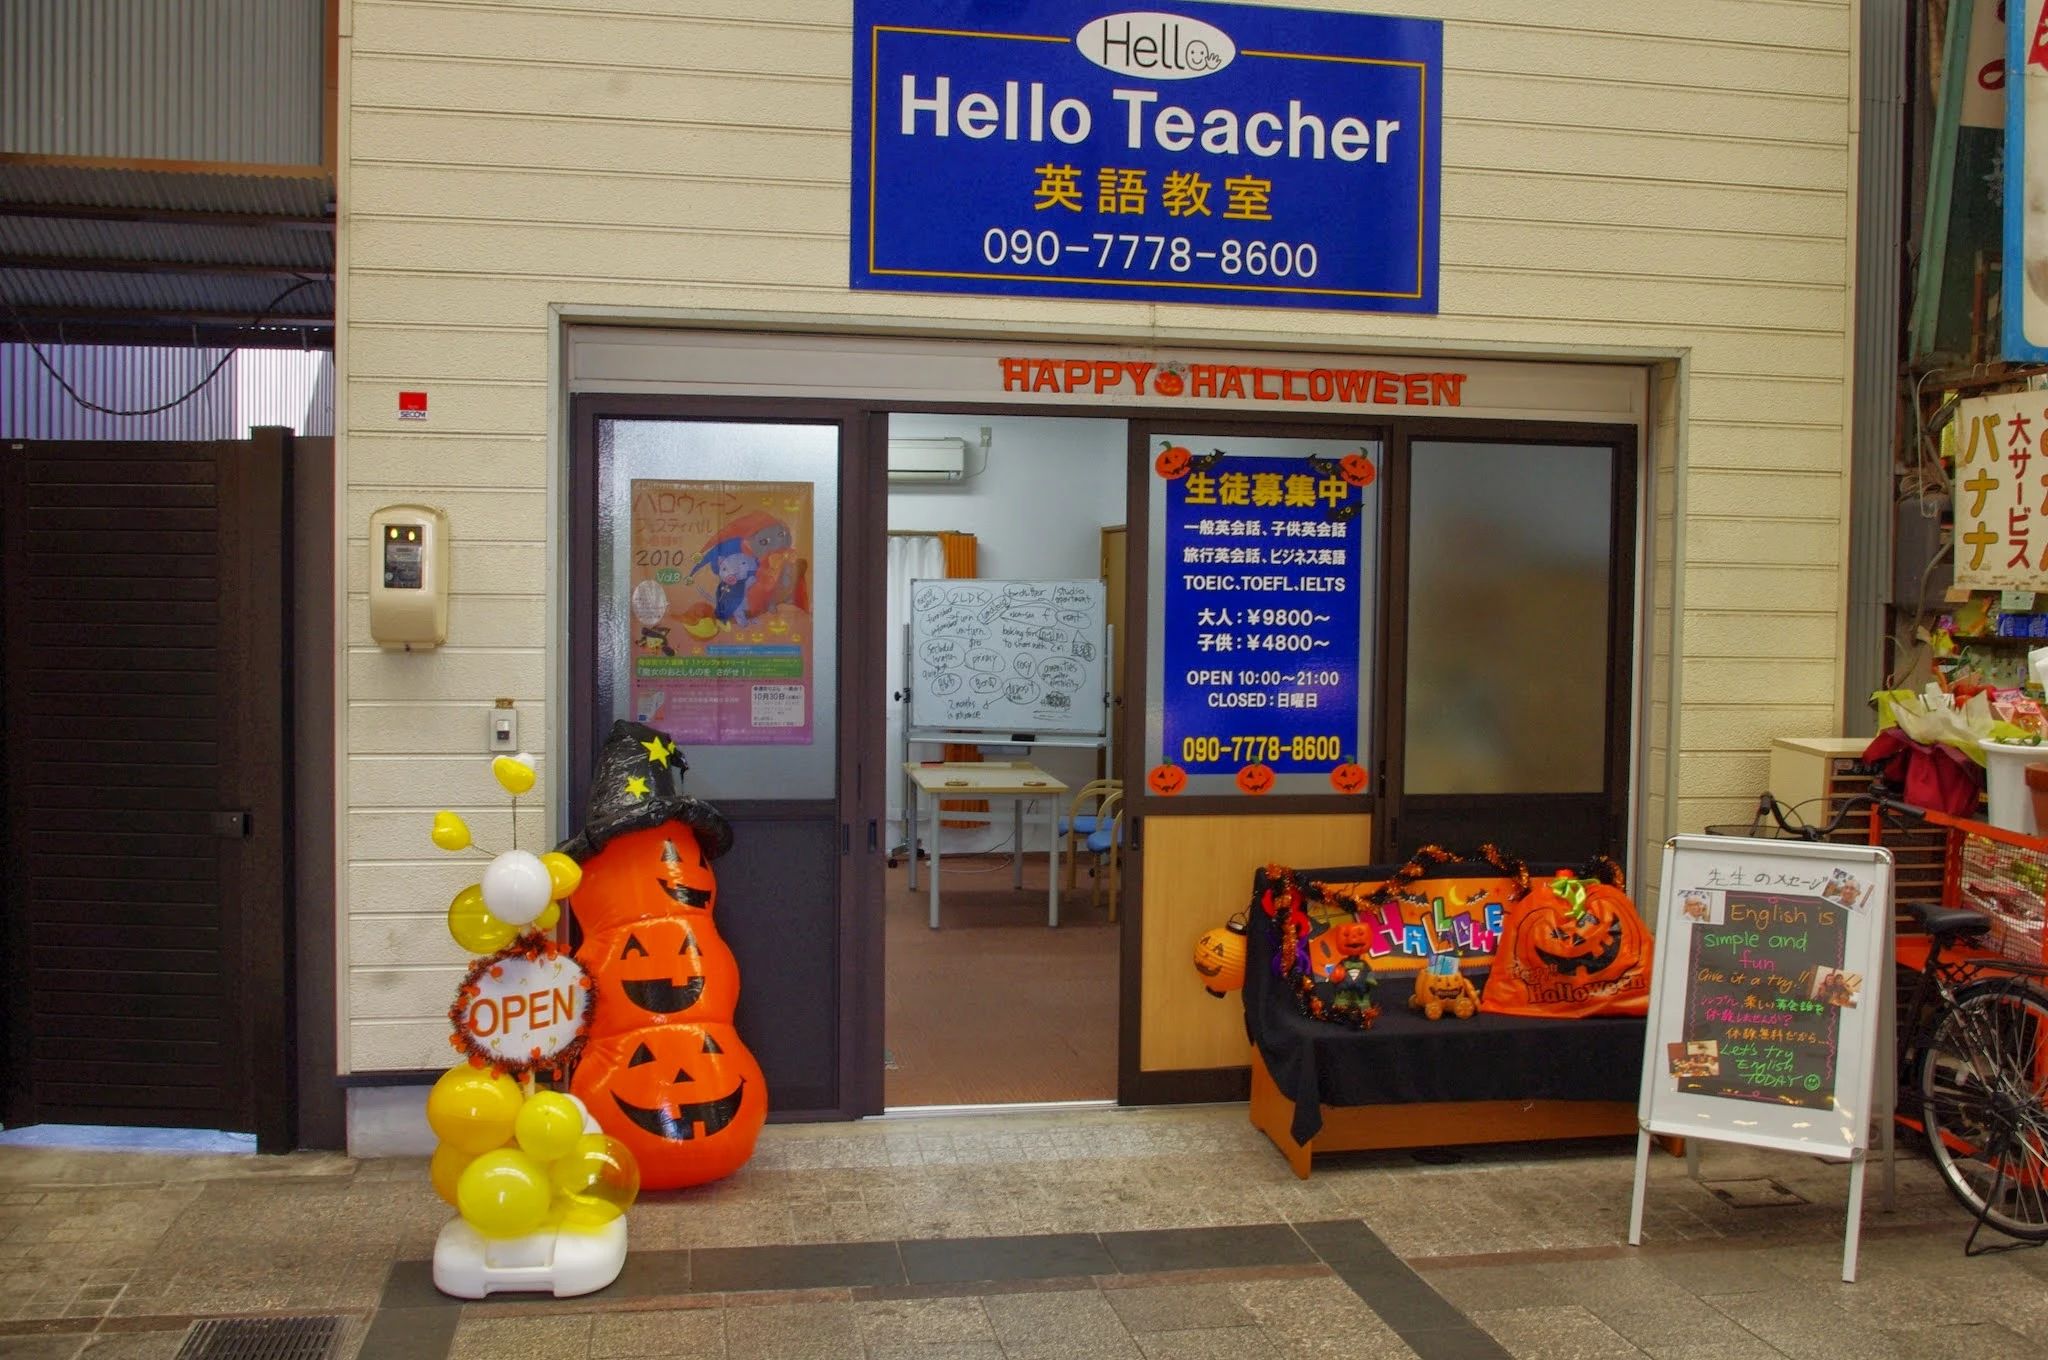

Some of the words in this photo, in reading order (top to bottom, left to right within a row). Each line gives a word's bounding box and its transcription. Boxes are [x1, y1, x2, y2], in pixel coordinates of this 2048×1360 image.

[900, 74, 1092, 144] Hello
[1112, 88, 1400, 163] Teacher
[1033, 163, 1273, 221] 英語教室
[983, 227, 1319, 279] 090-7778-8600
[1001, 357, 1153, 396] HAPPY
[1189, 363, 1463, 406] HALLOWEEN
[1184, 472, 1348, 508] 生徒募集中
[1963, 414, 2001, 571] バナナ
[2007, 412, 2032, 569] 大サービス
[636, 549, 684, 567] 2010
[1186, 670, 1233, 686] OPEN
[1183, 736, 1340, 762] 090-7778-8600
[1730, 903, 1807, 931] English
[1817, 905, 1835, 926] is
[1768, 931, 1808, 953] and
[1738, 948, 1776, 971] fun
[1697, 967, 1724, 983] Give
[1730, 971, 1746, 984] it
[1750, 975, 1761, 985] a
[469, 984, 576, 1038] OPEN
[1720, 1042, 1758, 1056] Let's
[1735, 1058, 1794, 1076] English
